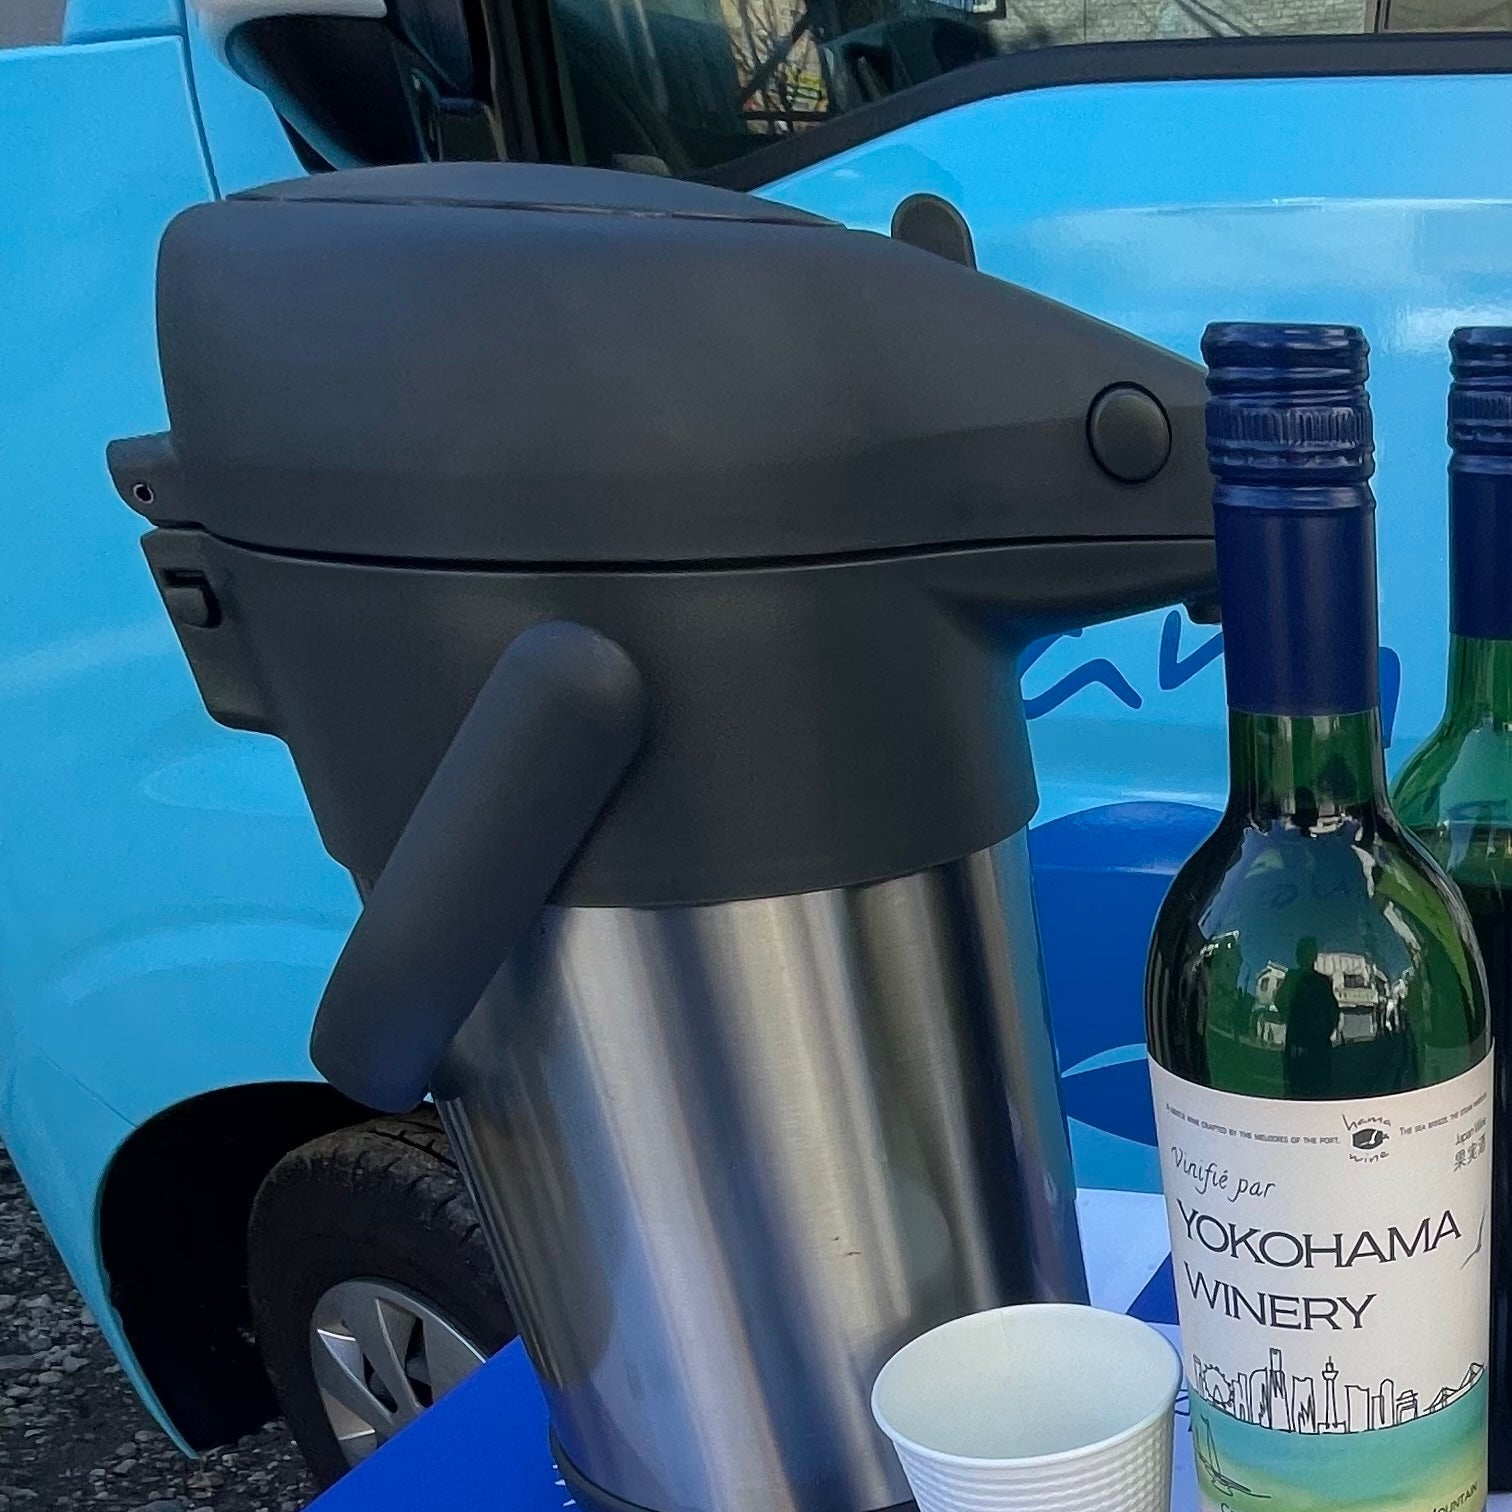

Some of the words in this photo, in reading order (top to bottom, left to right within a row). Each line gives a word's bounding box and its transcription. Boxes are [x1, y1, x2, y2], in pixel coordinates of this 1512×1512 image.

[1226, 1178, 1277, 1203] par
[1176, 1198, 1462, 1269] YOKOHAMA
[1184, 1260, 1377, 1330] WINERY
